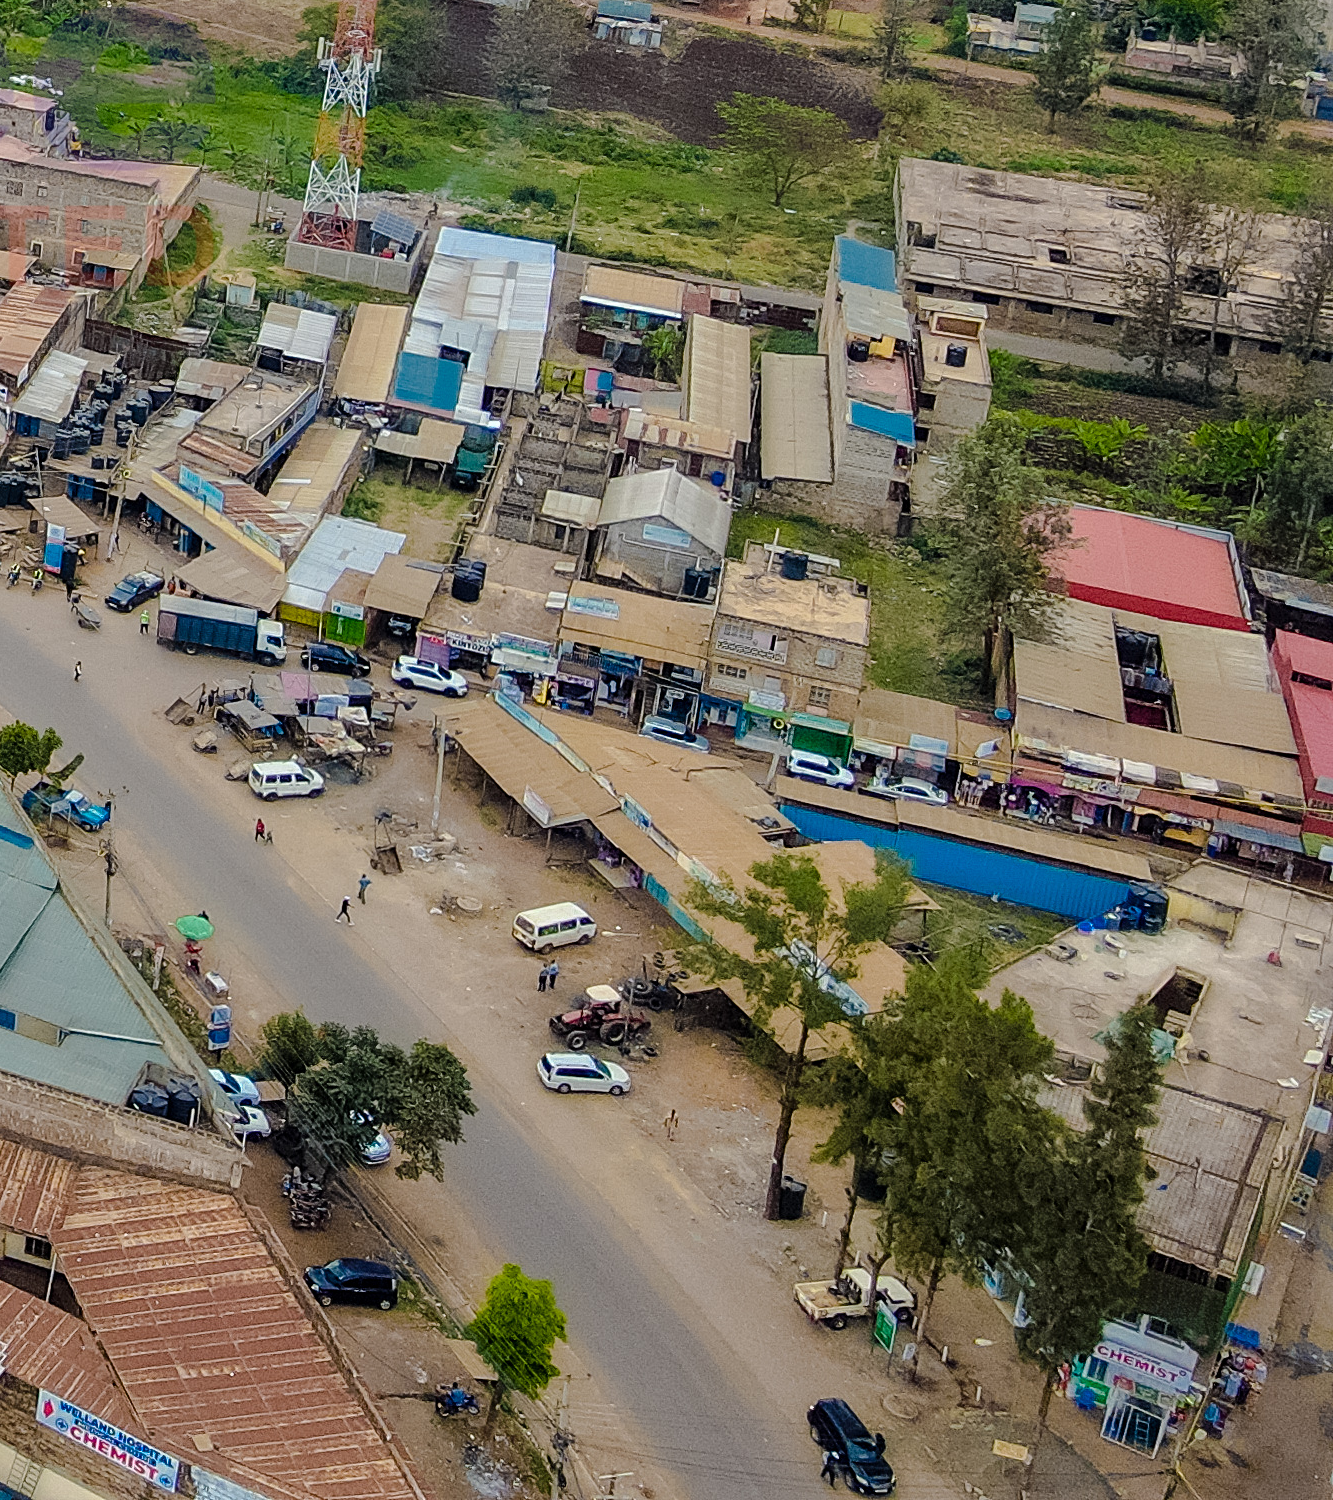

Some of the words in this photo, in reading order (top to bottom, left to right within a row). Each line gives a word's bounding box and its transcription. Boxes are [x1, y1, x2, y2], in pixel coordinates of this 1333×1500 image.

[1097, 1345, 1179, 1382] CHEMIST
[59, 1400, 116, 1436] WELLAND
[118, 1431, 174, 1468] HOSPITAL
[70, 1426, 159, 1481] CHEMIST
